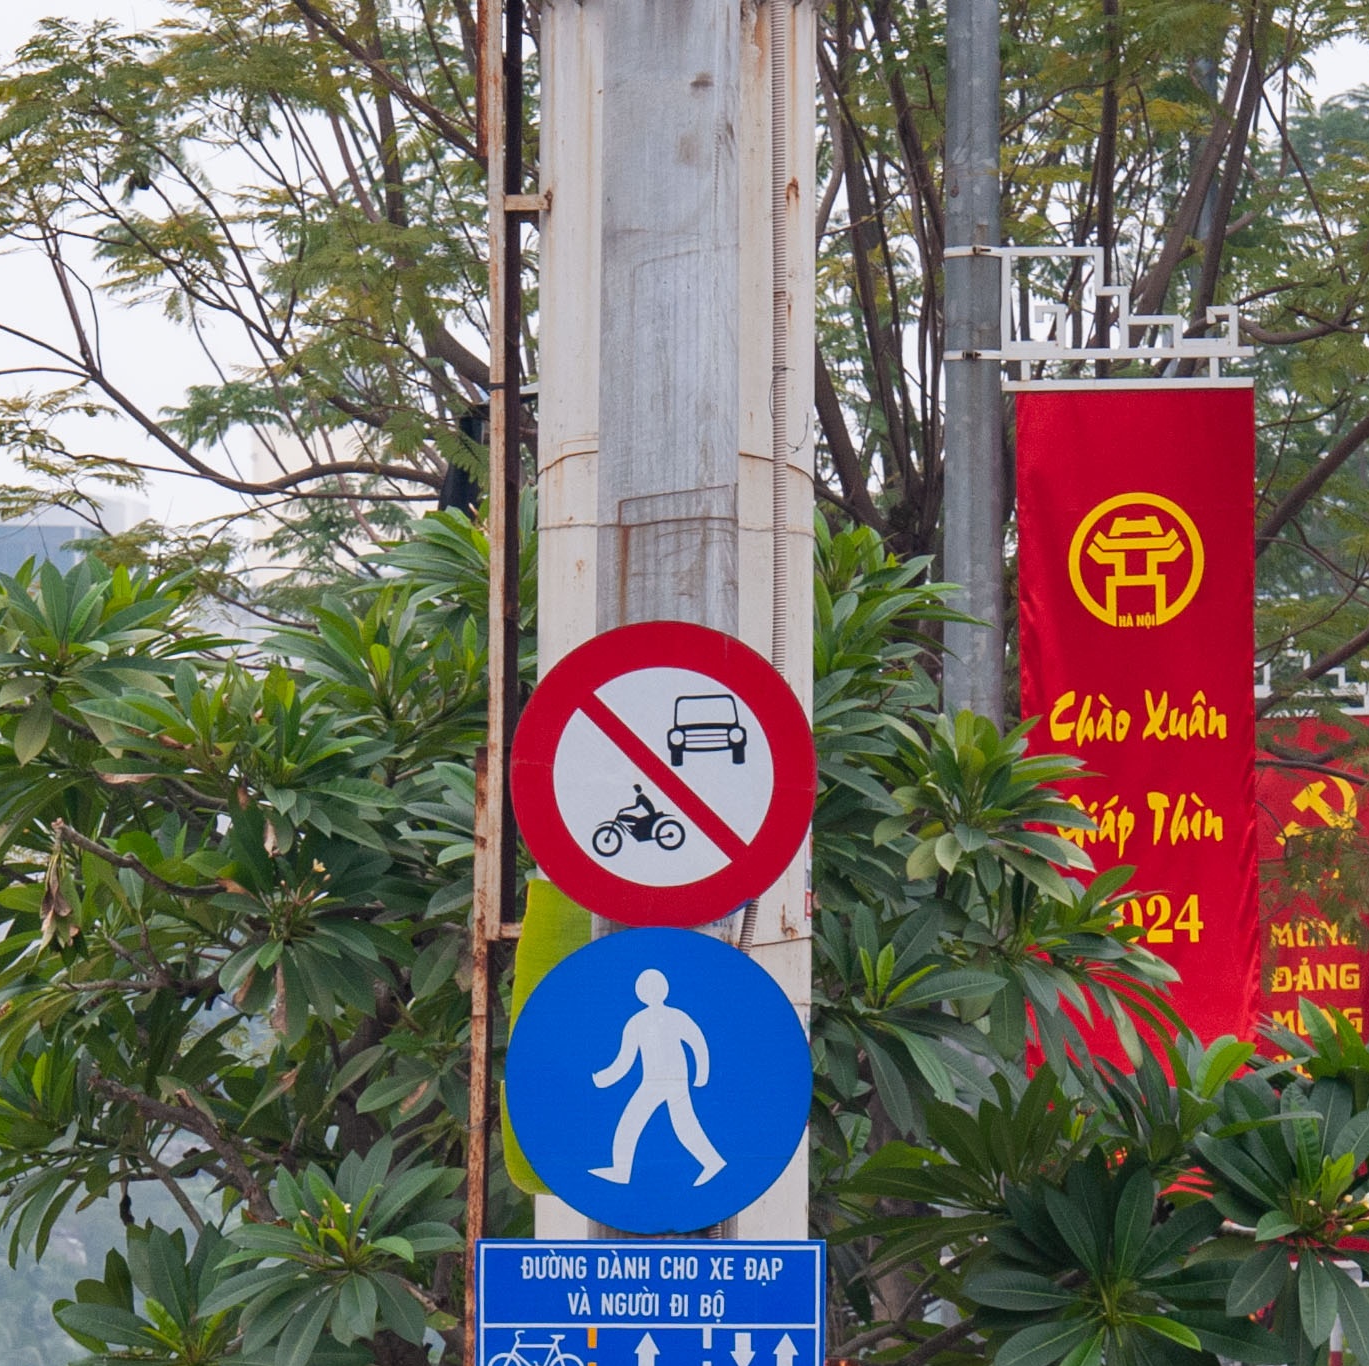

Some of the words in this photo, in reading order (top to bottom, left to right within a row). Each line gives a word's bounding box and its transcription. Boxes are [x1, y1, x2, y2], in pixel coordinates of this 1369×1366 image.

[1118, 612, 1134, 627] HÀ
[1136, 611, 1155, 629] NỘI
[1050, 690, 1131, 747] Chào
[1142, 689, 1227, 741] Xuân
[1147, 791, 1224, 846] Thìn
[1271, 957, 1360, 992] ĐẢNG
[521, 1249, 587, 1280] ĐƯỜNG
[597, 1250, 650, 1280] DÀNH
[660, 1256, 698, 1280] CHO
[710, 1257, 734, 1281] XE
[744, 1257, 783, 1286] ĐẠP
[568, 1286, 591, 1315] VÀ
[601, 1286, 659, 1316] NGƯỜI
[669, 1294, 689, 1318] ĐI
[700, 1289, 725, 1323] BỘ
